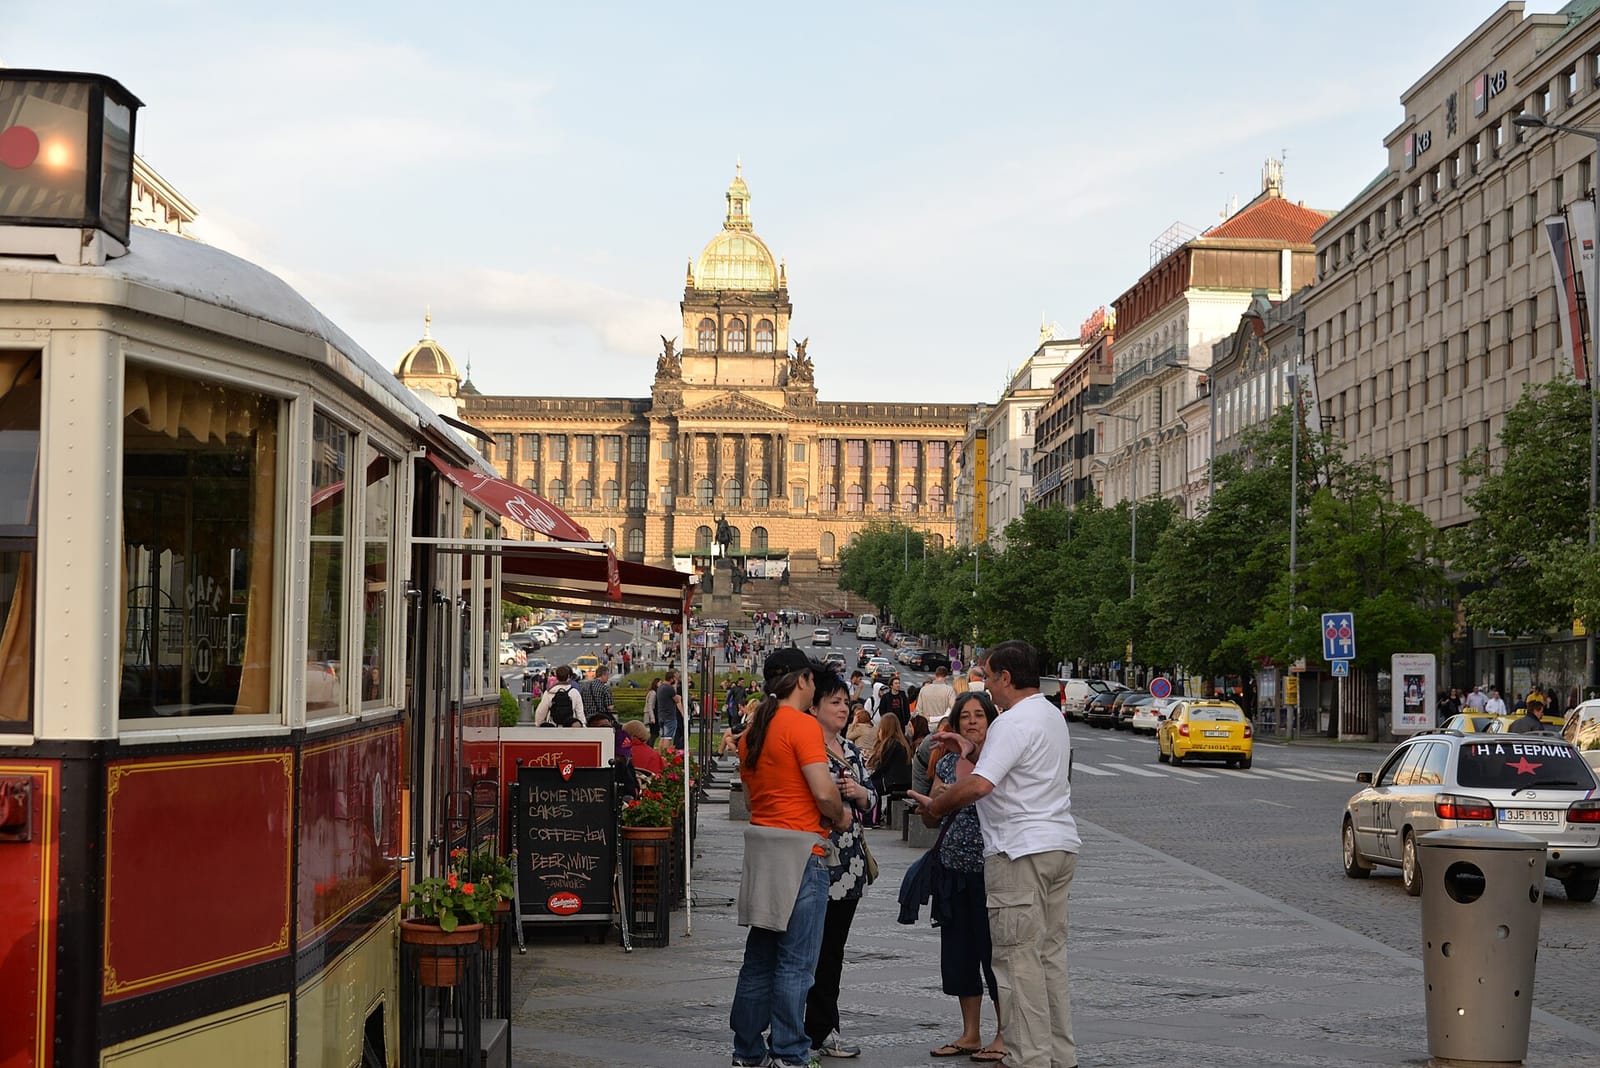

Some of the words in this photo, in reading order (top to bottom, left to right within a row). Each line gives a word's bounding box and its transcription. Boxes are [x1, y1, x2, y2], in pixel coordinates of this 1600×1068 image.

[1488, 70, 1507, 99] KB
[1415, 130, 1432, 156] KB
[528, 751, 573, 768] CAF
[528, 785, 569, 803] HOME
[571, 787, 607, 803] MADE
[528, 804, 574, 820] CAKES
[1507, 810, 1525, 820] 3J5
[1533, 810, 1554, 821] 1193
